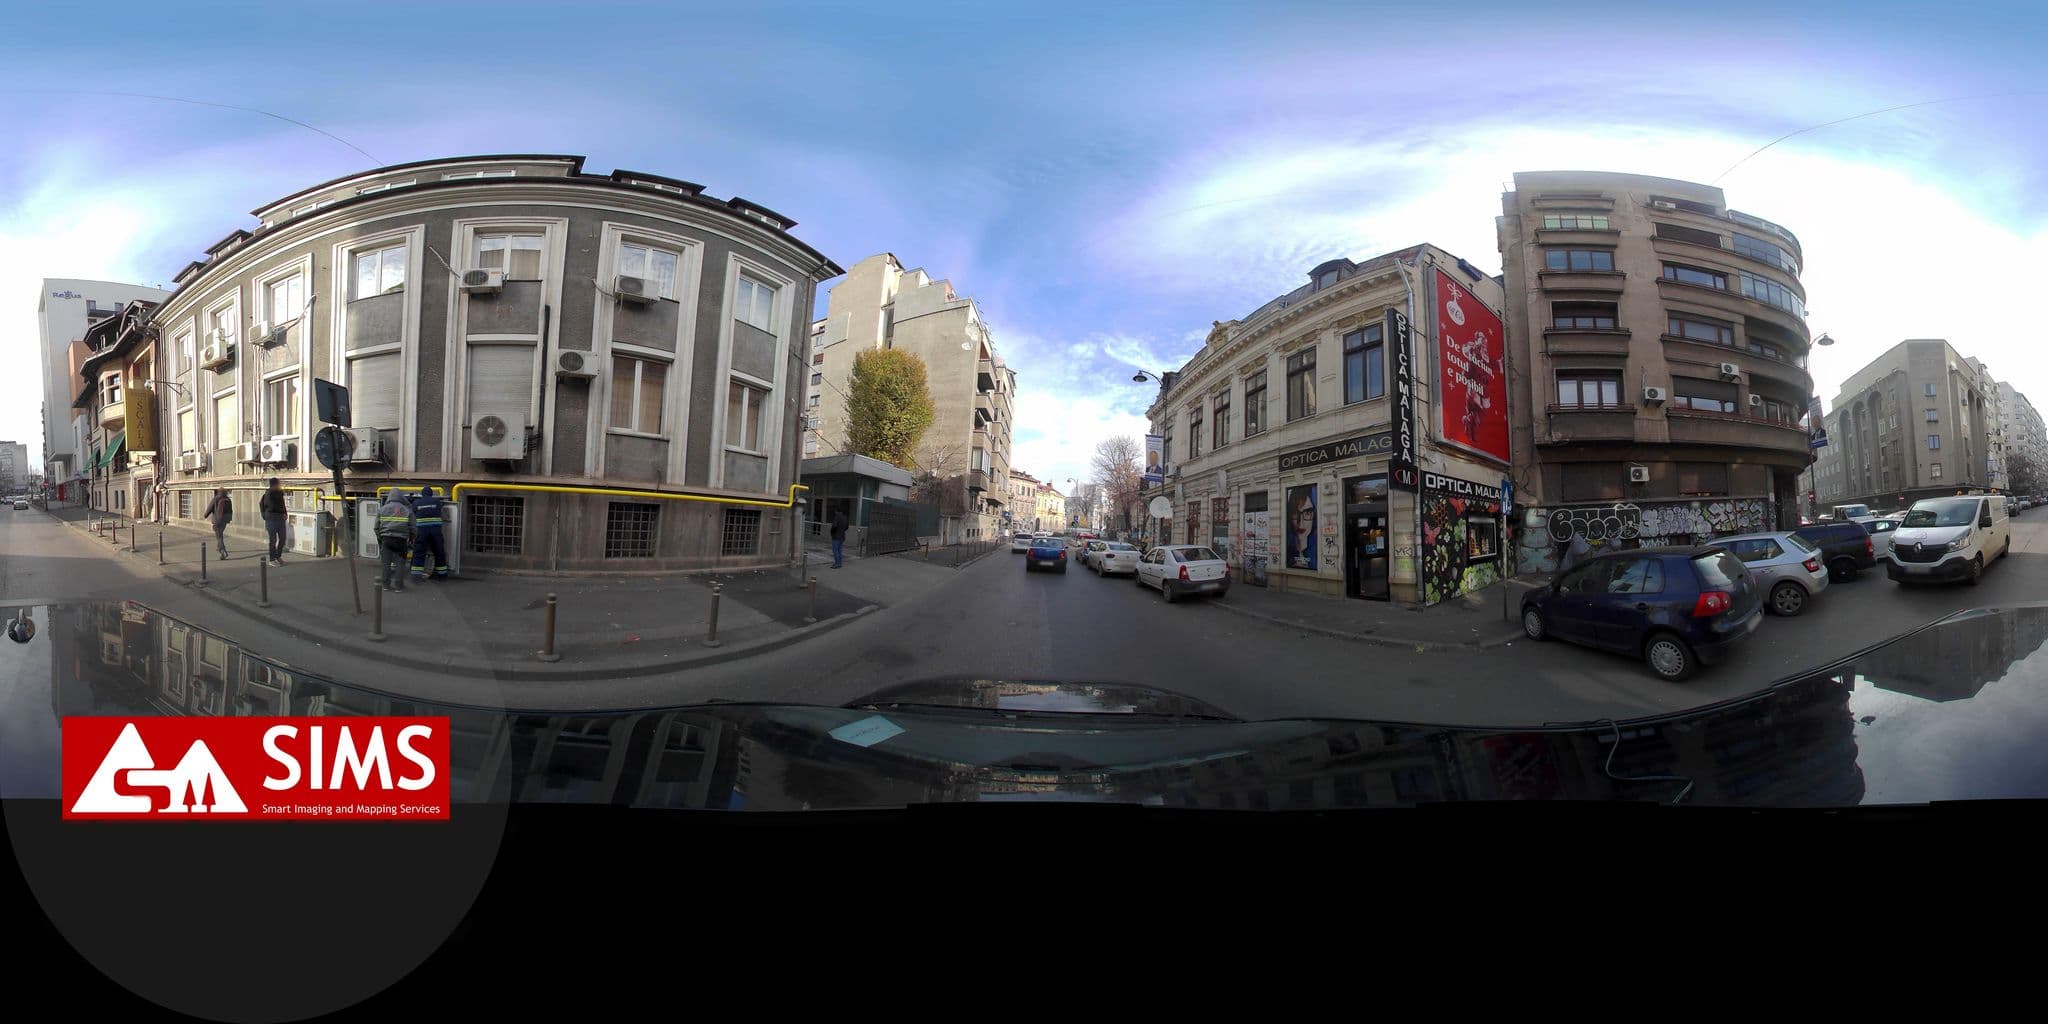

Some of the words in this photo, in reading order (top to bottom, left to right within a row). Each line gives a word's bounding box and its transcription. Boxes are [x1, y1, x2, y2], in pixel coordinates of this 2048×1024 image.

[1396, 313, 1408, 379] OPTICA
[1446, 335, 1460, 352] De
[1447, 351, 1469, 372] totul
[1447, 367, 1454, 377] e
[1455, 371, 1484, 396] posibil
[136, 401, 145, 448] SCALA
[1399, 380, 1411, 463] MALAGA
[1282, 451, 1328, 468] OPTICA
[1335, 436, 1392, 457] MALAG
[1426, 474, 1473, 495] OPTICA
[1475, 484, 1502, 500] MALA
